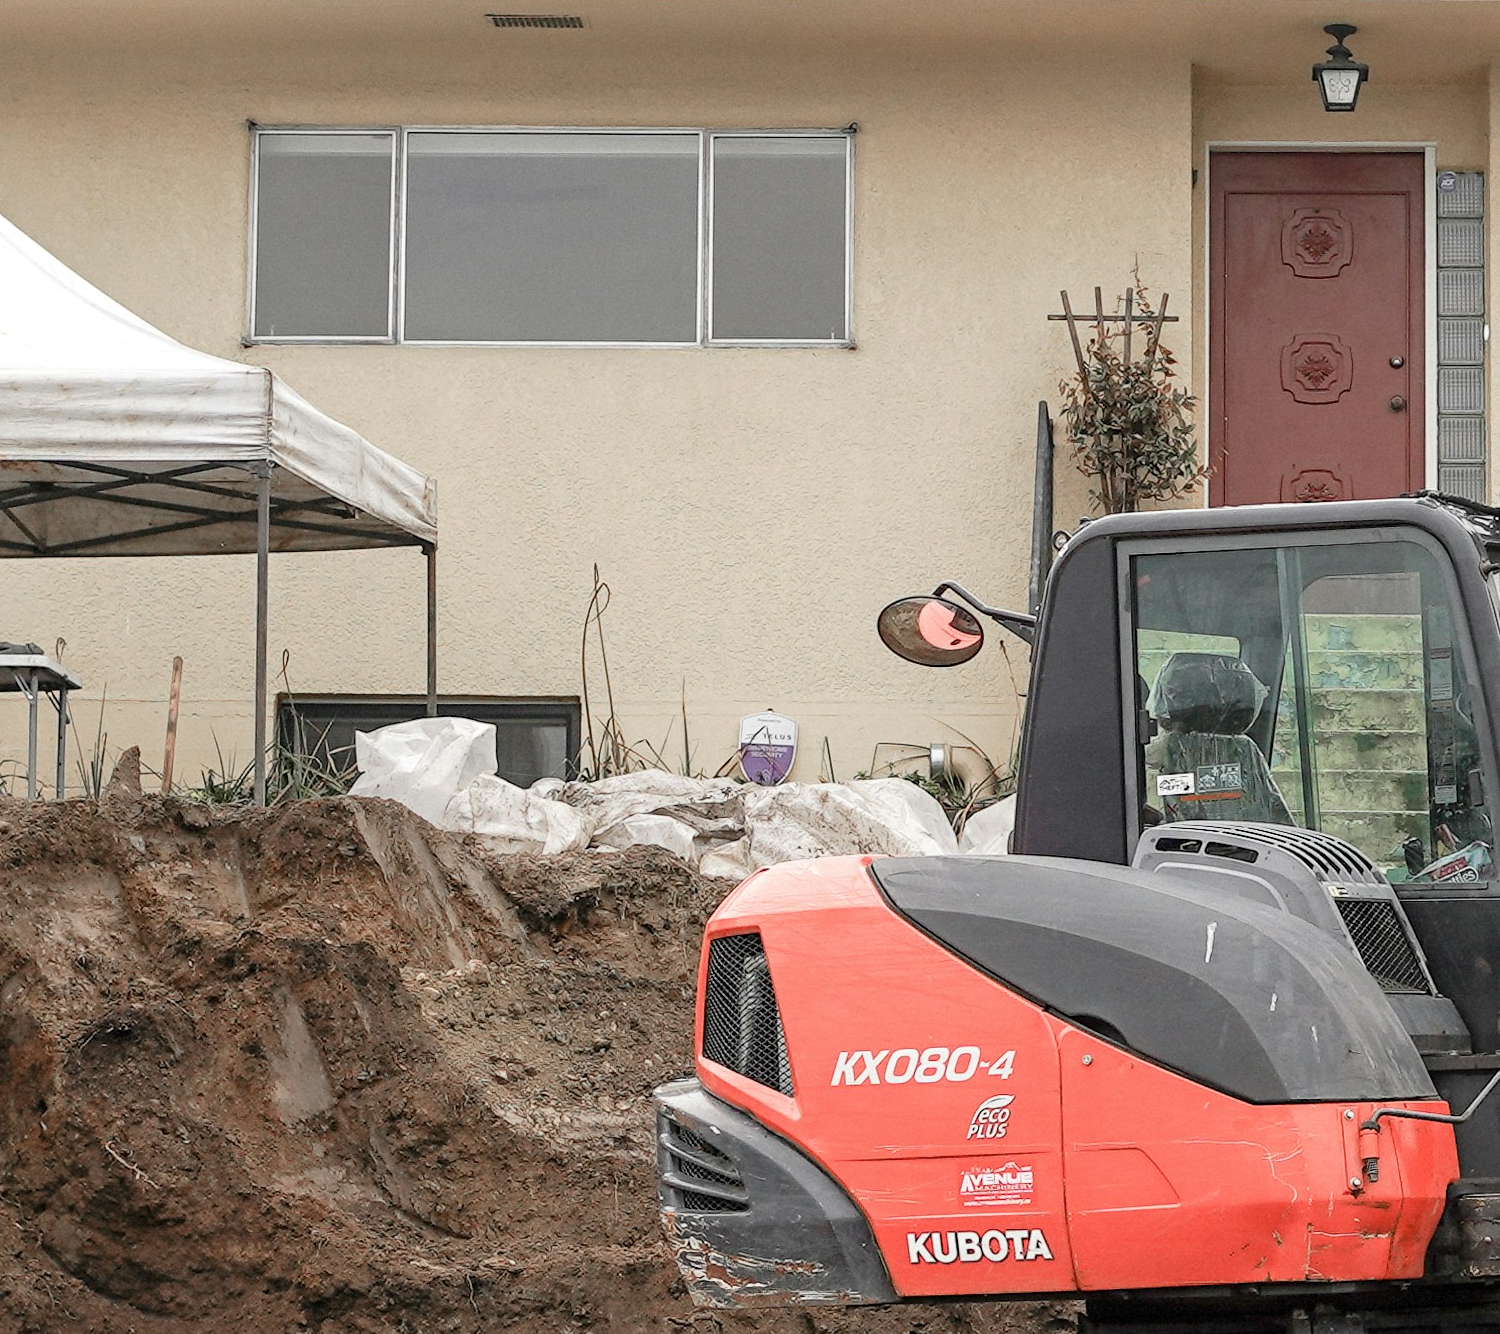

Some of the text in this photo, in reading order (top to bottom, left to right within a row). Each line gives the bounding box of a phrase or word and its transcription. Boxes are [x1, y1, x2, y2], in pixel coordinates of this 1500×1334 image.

[831, 1046, 1016, 1086] KX080-4
[978, 1108, 1011, 1124] eco
[966, 1123, 1009, 1140] PLUS
[906, 1229, 1053, 1264] KUBOTA
